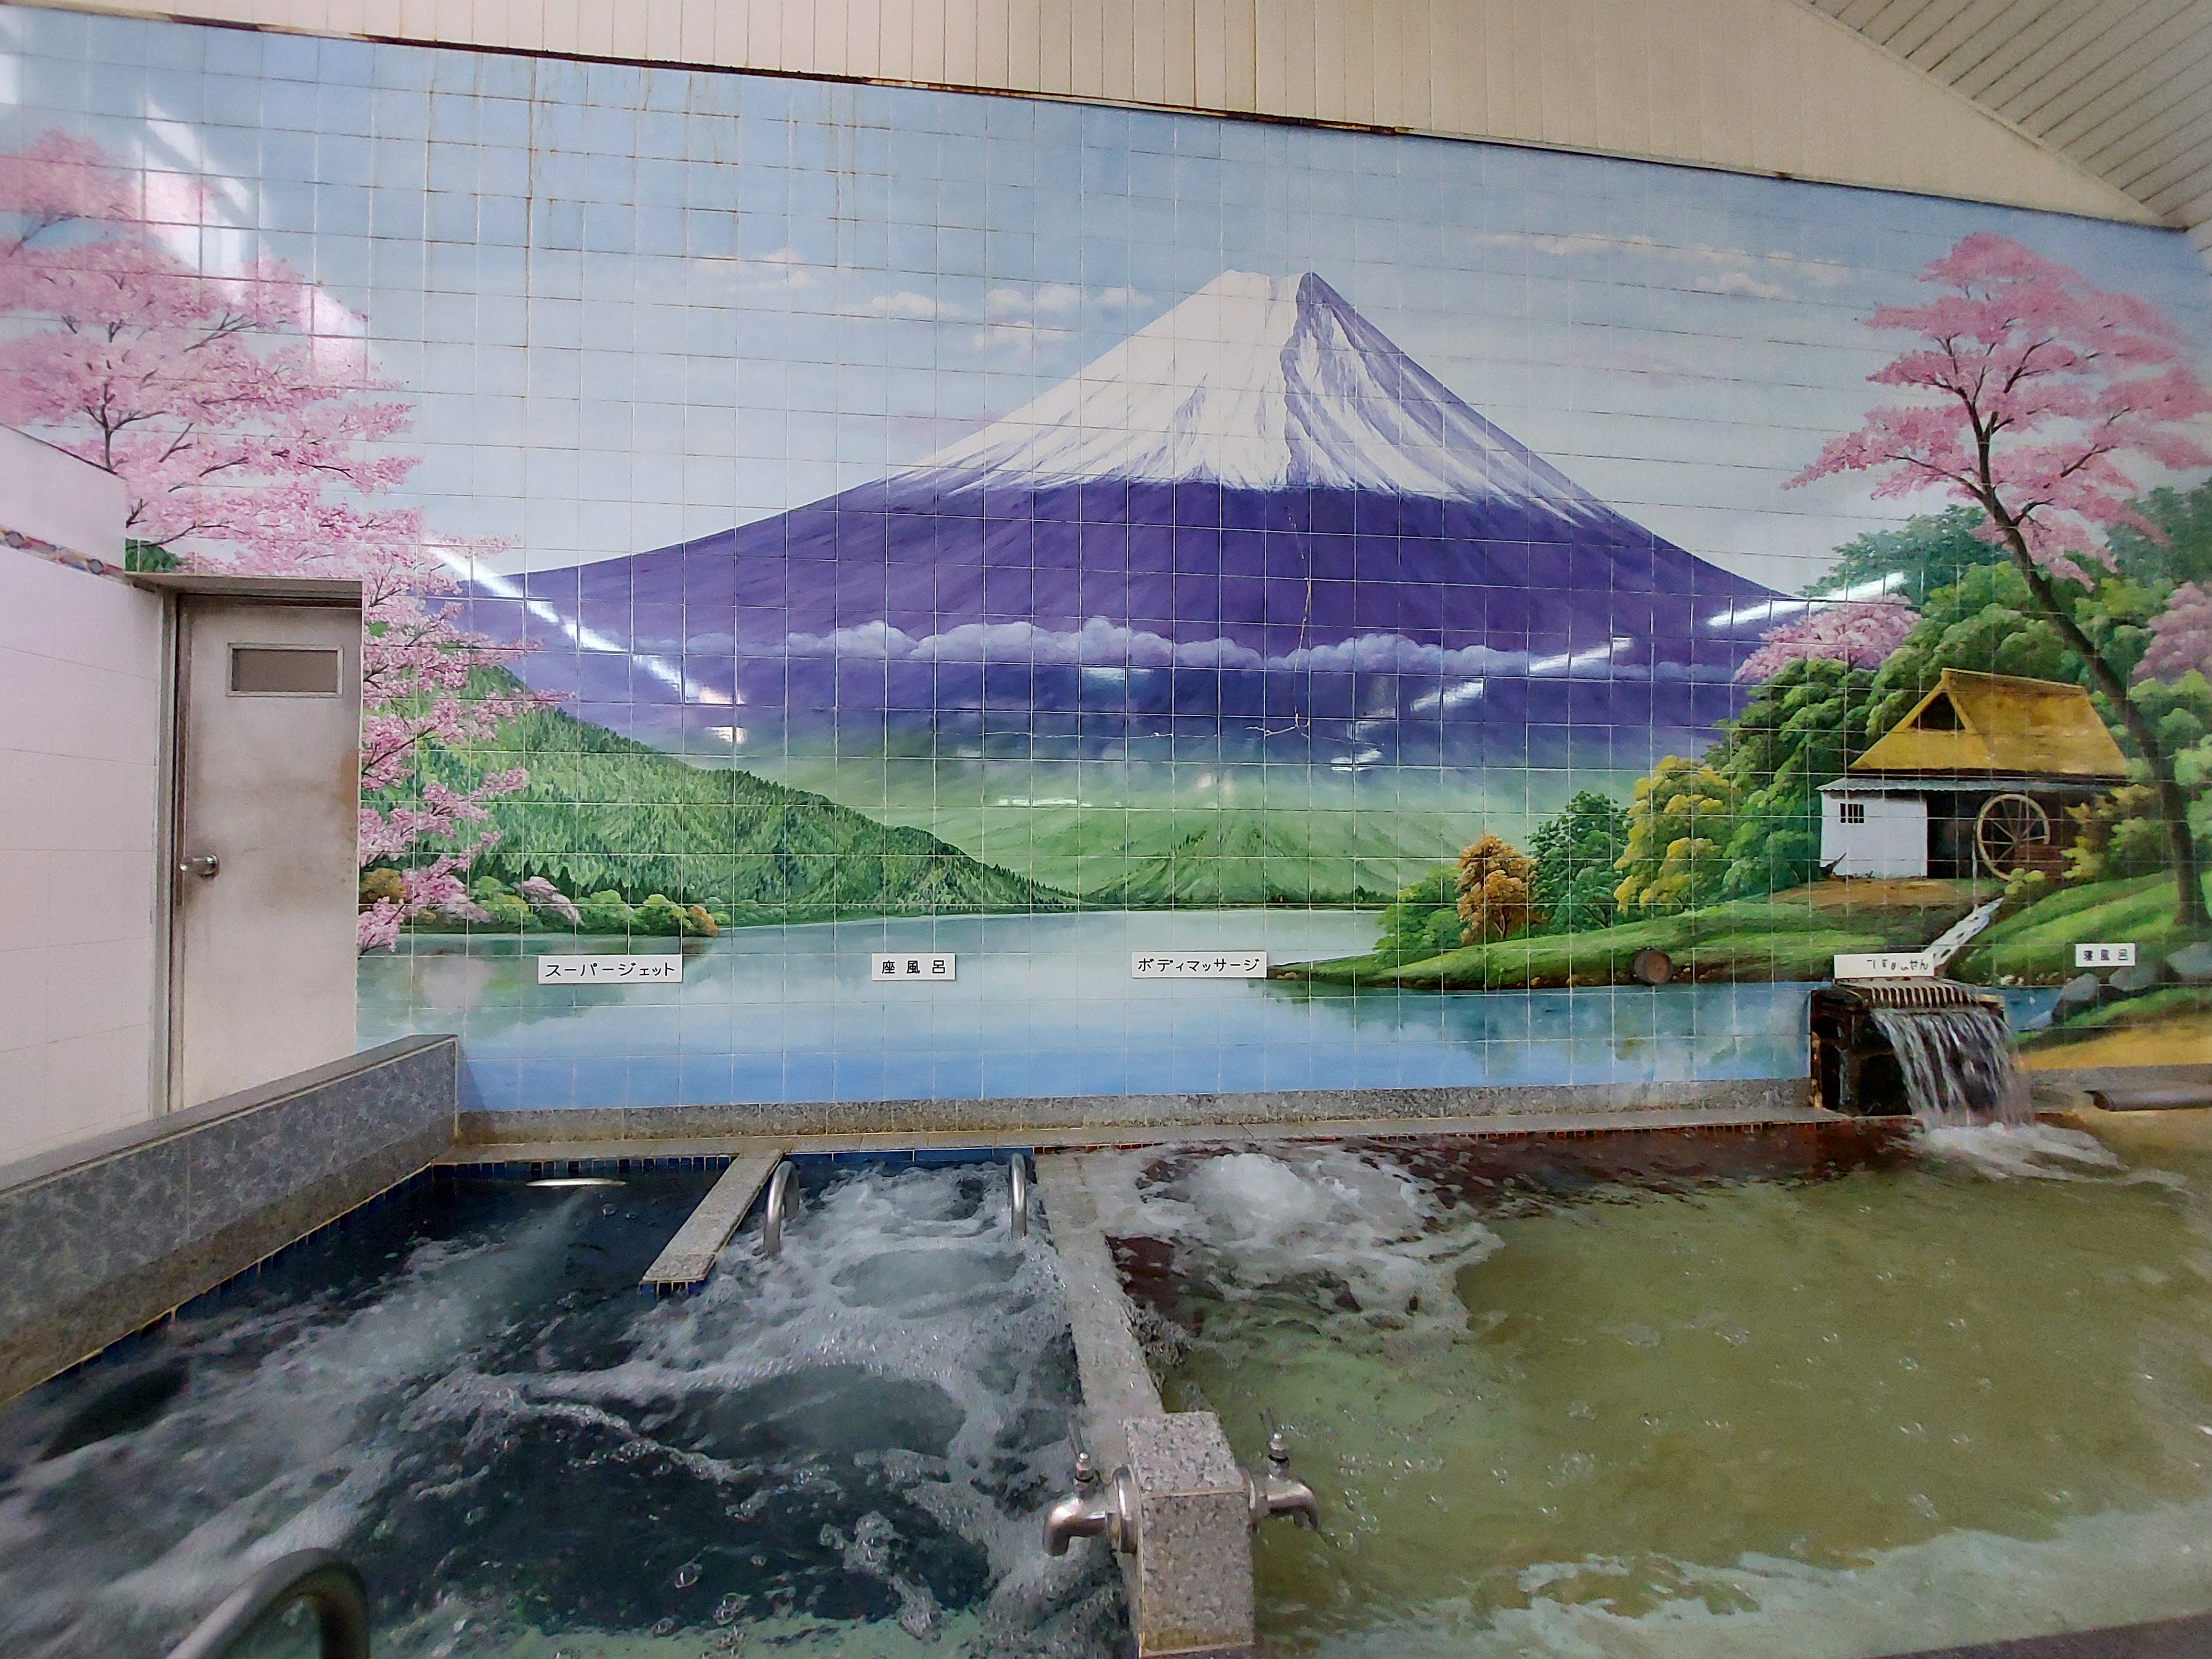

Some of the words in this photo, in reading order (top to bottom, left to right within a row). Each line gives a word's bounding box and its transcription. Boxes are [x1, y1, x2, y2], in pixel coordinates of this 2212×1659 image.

[545, 962, 675, 977] スーパージェット
[881, 959, 945, 974] 座風呂
[1138, 958, 1260, 972] ボディマッサージ
